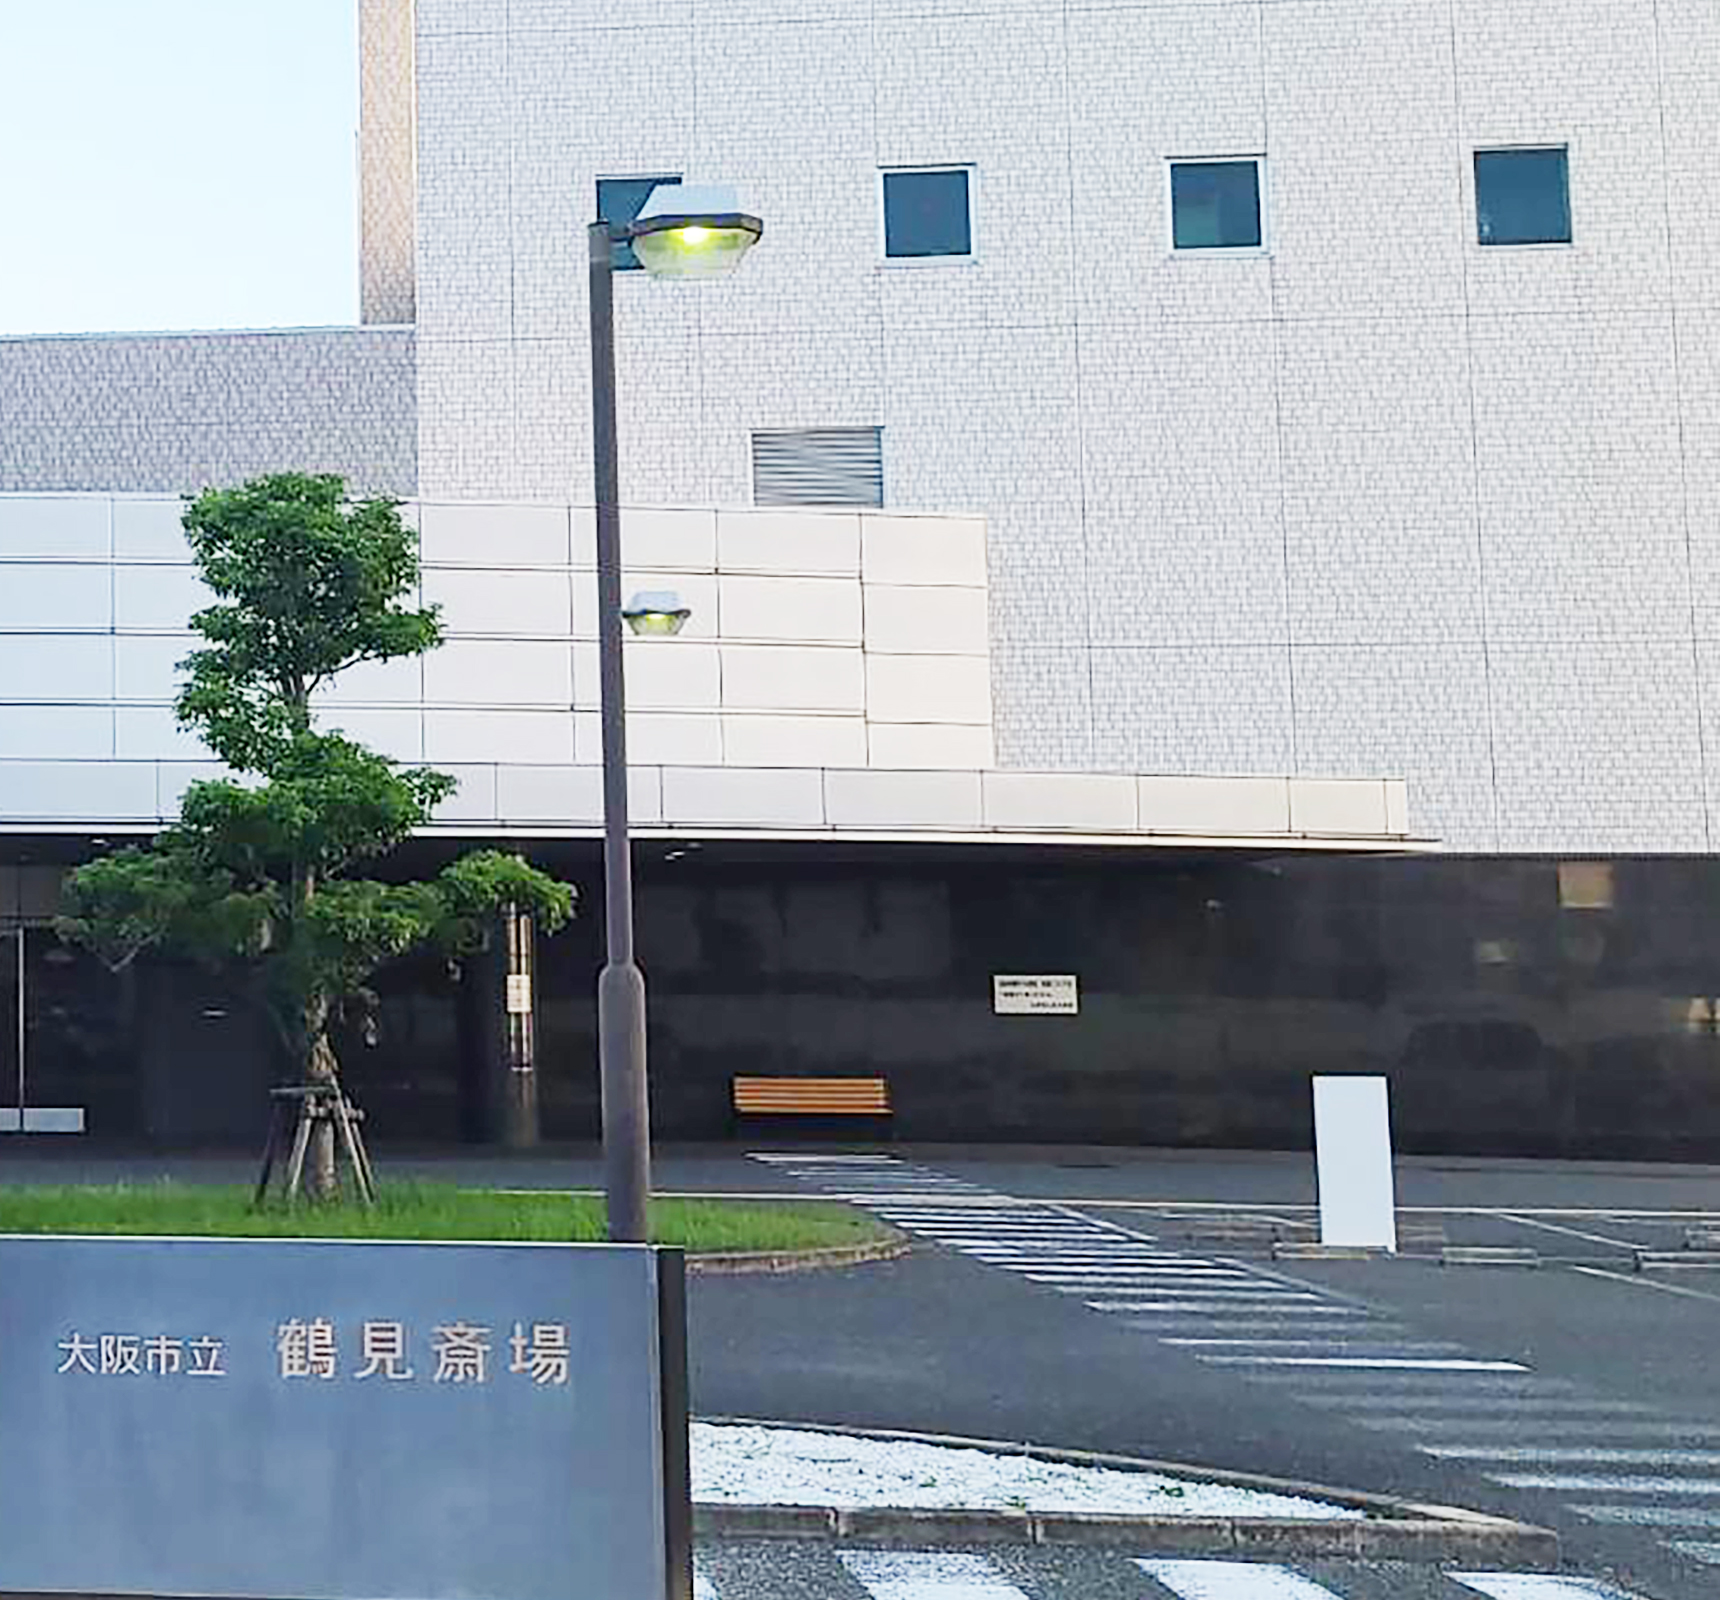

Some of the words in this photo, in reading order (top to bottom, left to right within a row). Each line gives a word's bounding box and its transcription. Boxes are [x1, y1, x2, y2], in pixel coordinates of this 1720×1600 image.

[57, 1333, 229, 1376] 大阪市立
[276, 1317, 572, 1386] 鶴見斎場
